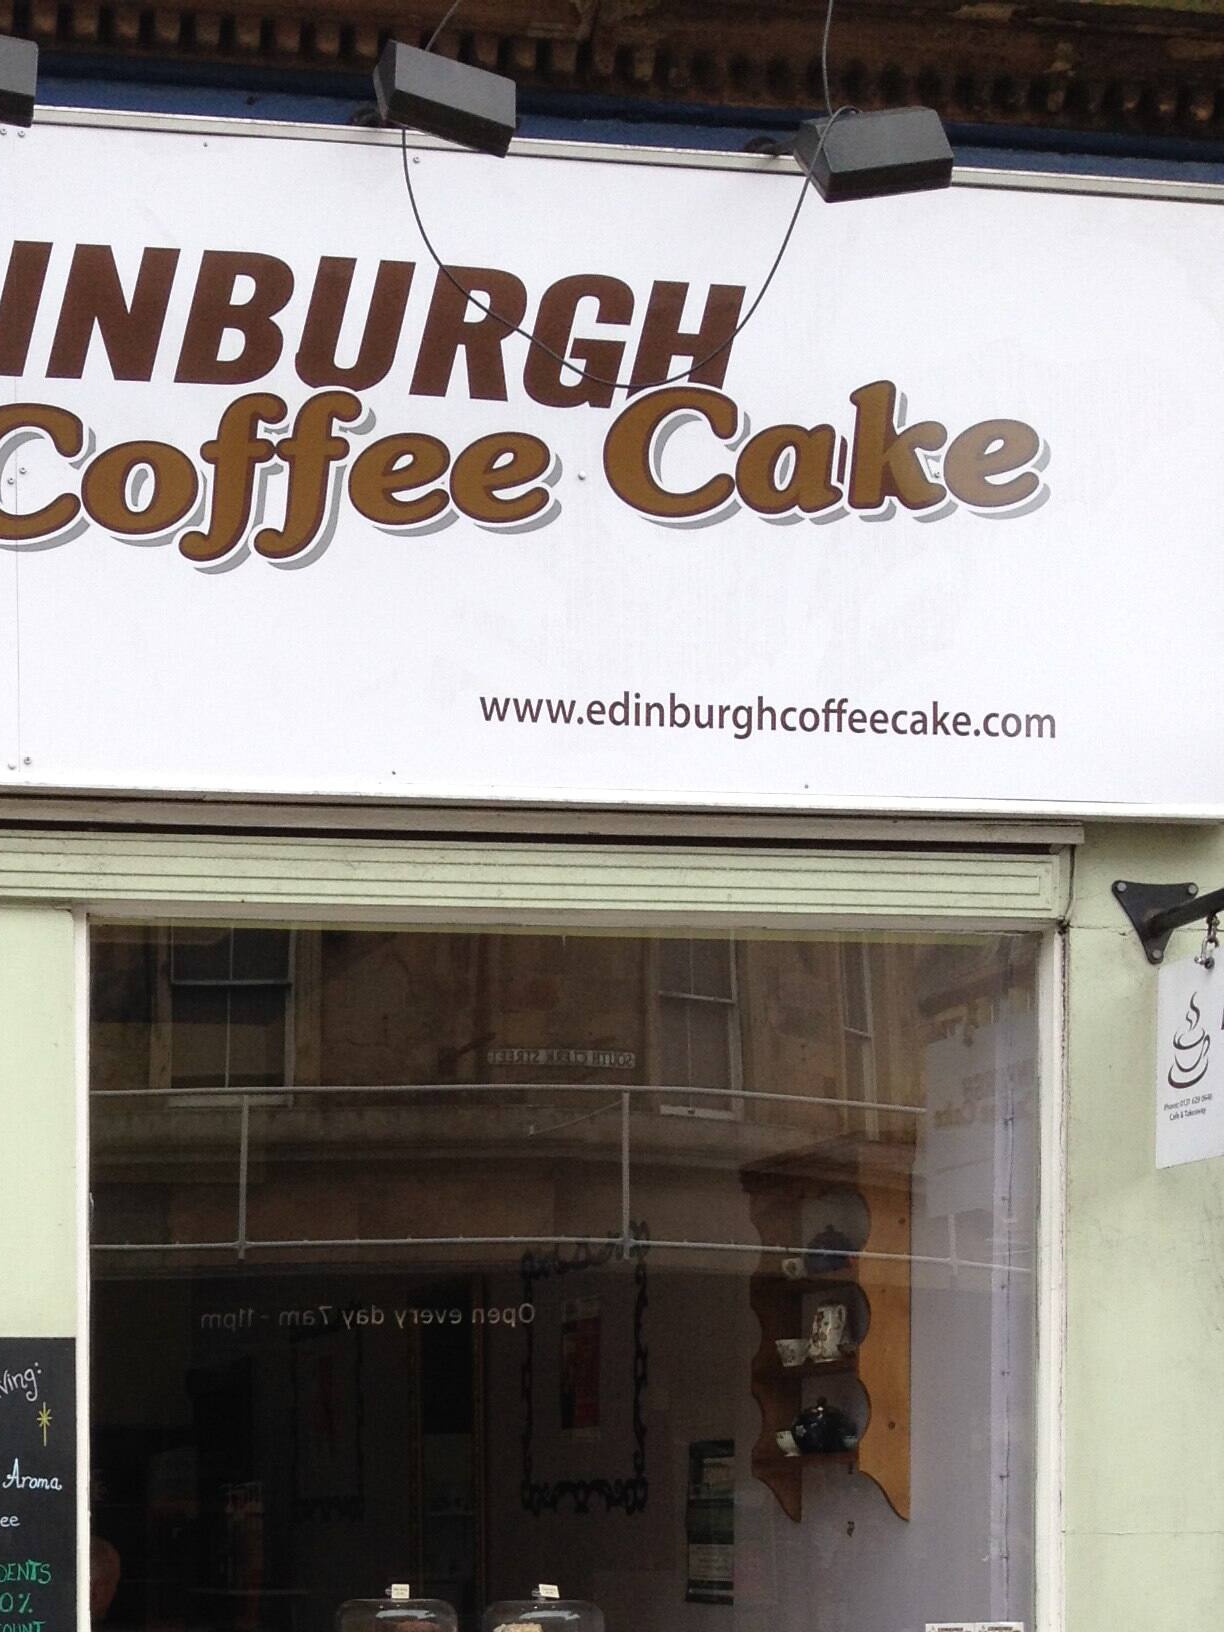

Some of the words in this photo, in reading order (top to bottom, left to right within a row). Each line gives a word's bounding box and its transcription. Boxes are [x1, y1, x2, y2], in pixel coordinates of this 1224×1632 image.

[603, 381, 1050, 526] Cake
[480, 691, 1057, 741] www.edinburghcoffeecake.com
[3, 1457, 63, 1491] Aroma
